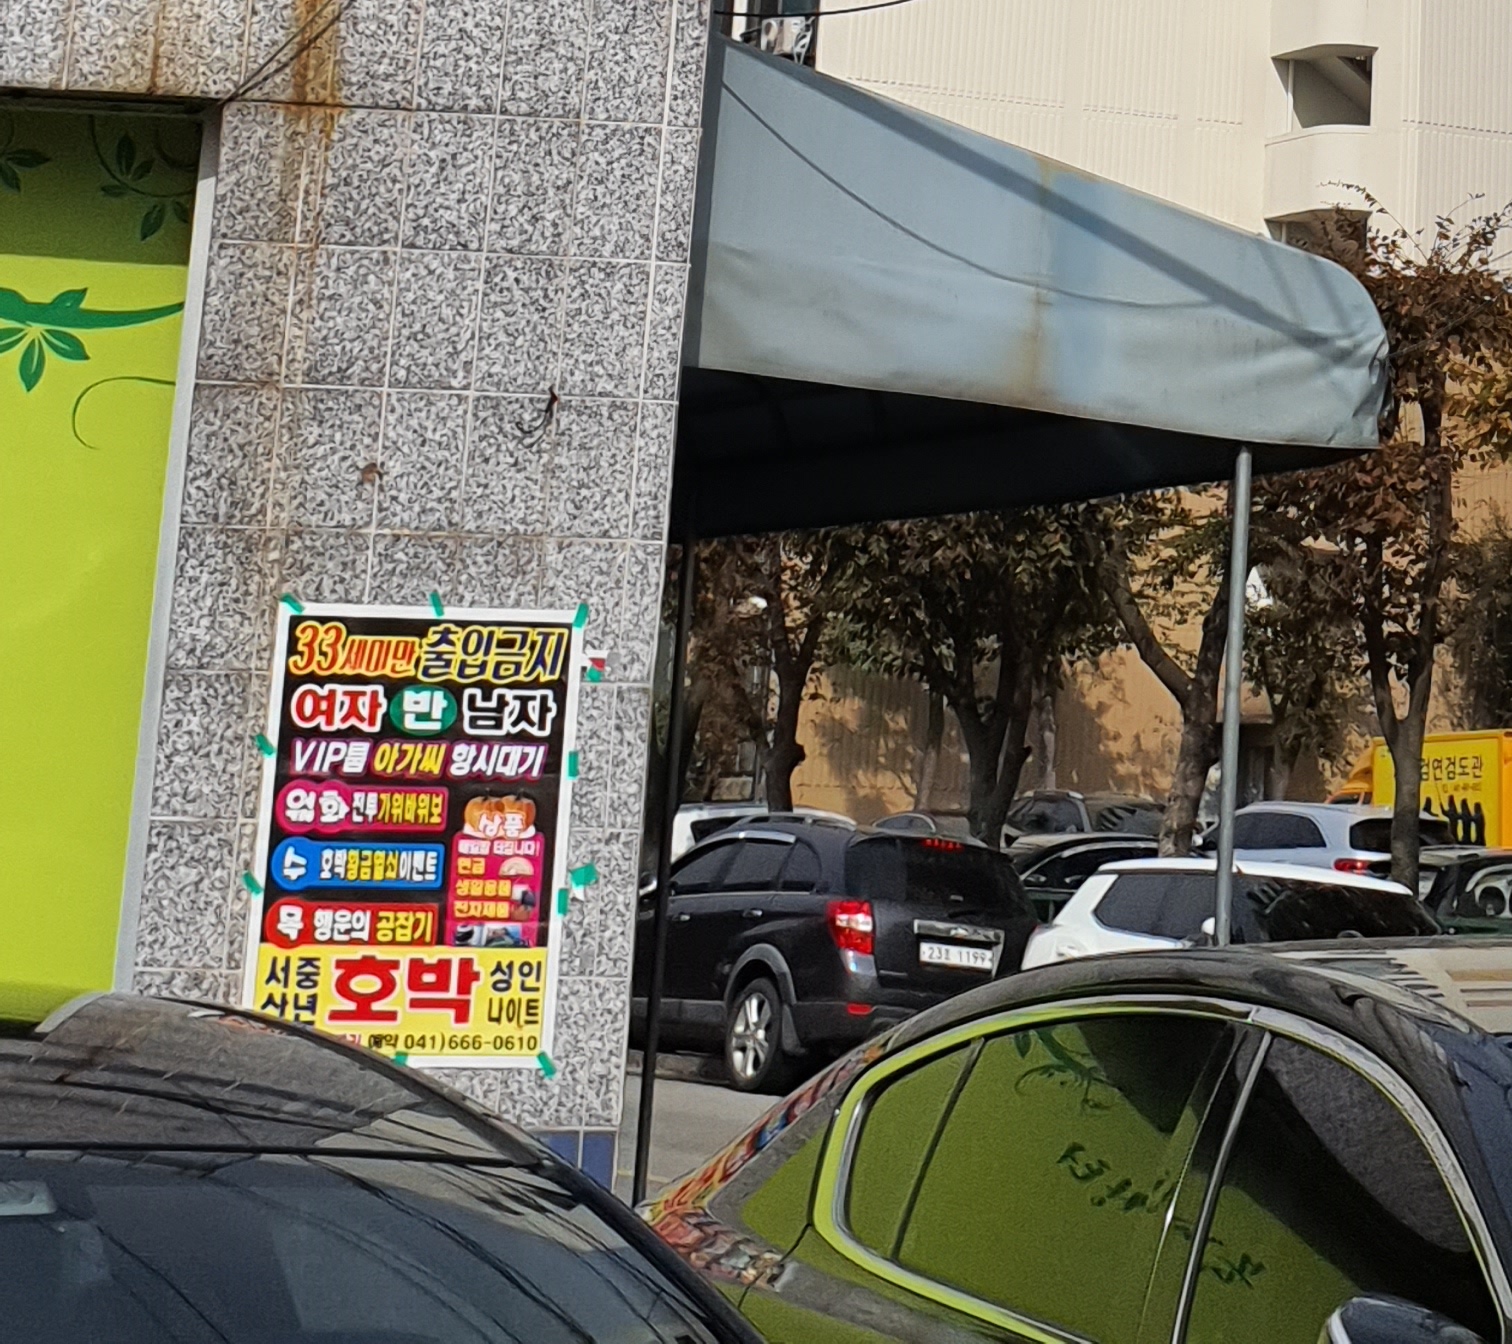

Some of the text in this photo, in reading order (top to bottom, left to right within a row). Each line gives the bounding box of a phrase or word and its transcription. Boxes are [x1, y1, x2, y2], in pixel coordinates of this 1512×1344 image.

[290, 622, 567, 682] 33세미만 출입금지
[293, 685, 557, 735] 여자 반 남자
[373, 741, 446, 775] 아가씨
[450, 743, 546, 777] 항시대기
[283, 846, 307, 881] 수
[313, 908, 371, 942] 행운의
[327, 954, 481, 1025] 호박
[490, 960, 542, 993] 성인
[488, 997, 540, 1026] 나이트
[403, 1033, 538, 1052] 041)666-0610
